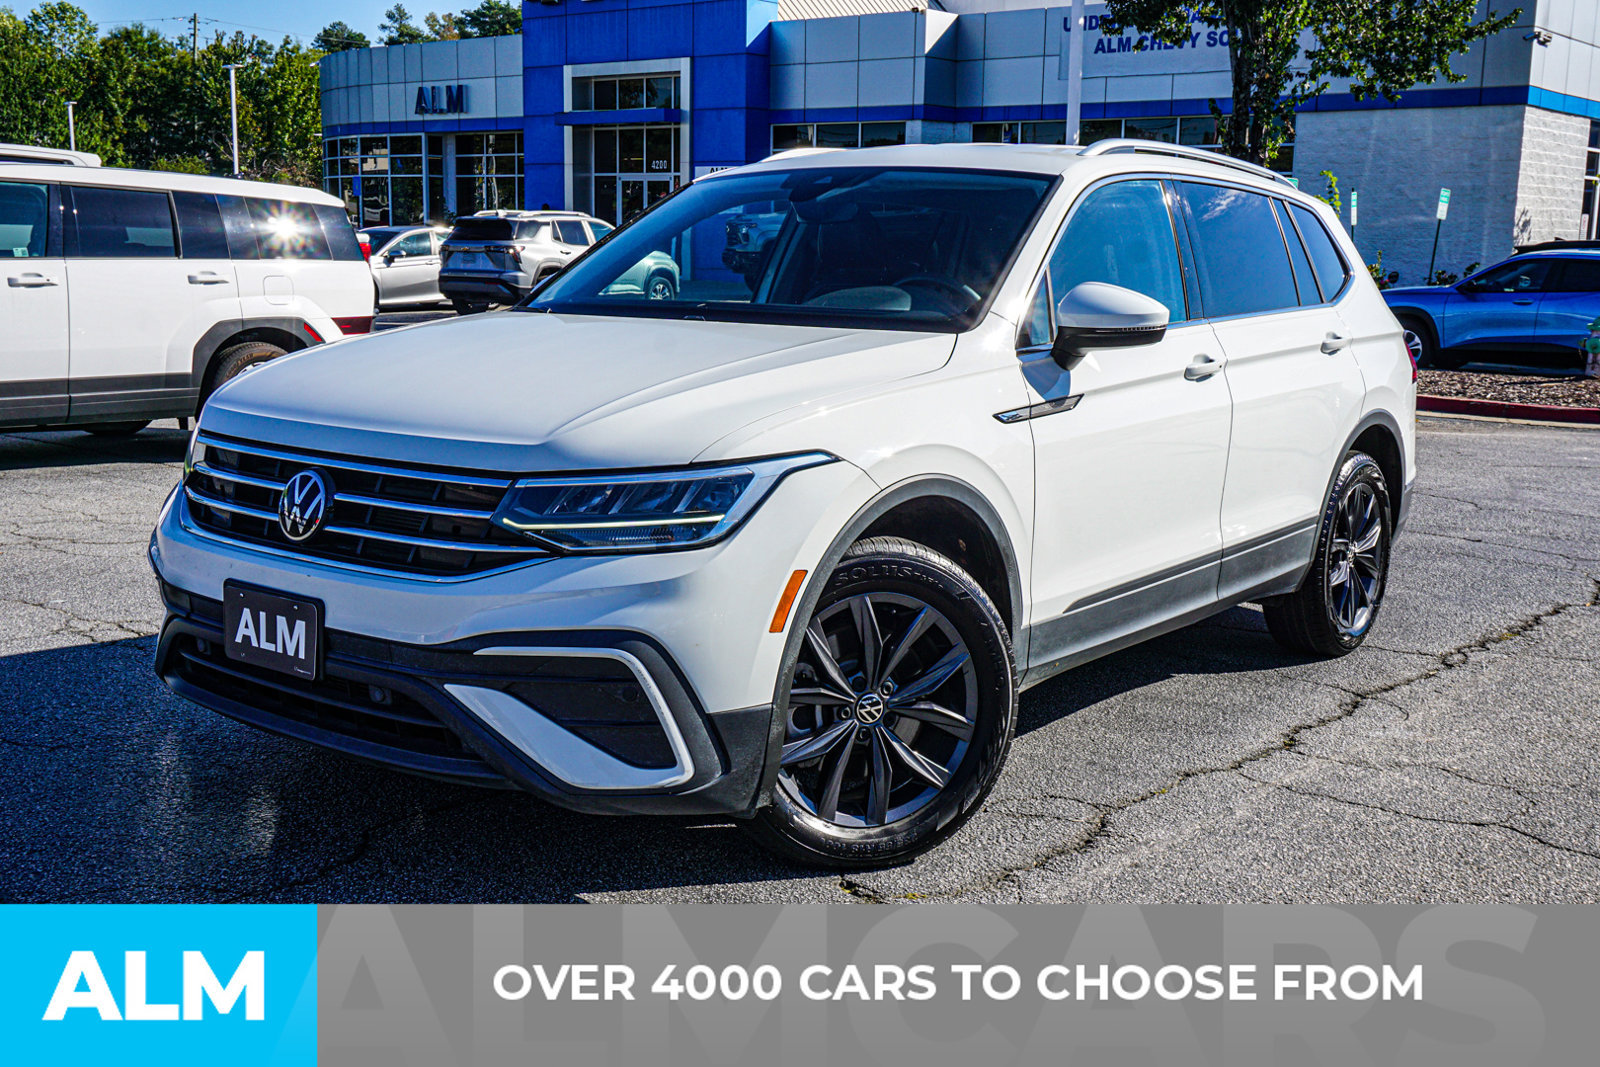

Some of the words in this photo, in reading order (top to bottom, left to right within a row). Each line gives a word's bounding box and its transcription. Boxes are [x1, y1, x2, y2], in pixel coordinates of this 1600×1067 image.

[1094, 37, 1132, 54] ALM
[414, 84, 469, 115] ALM
[651, 160, 668, 169] 4200
[235, 607, 306, 660] ALM
